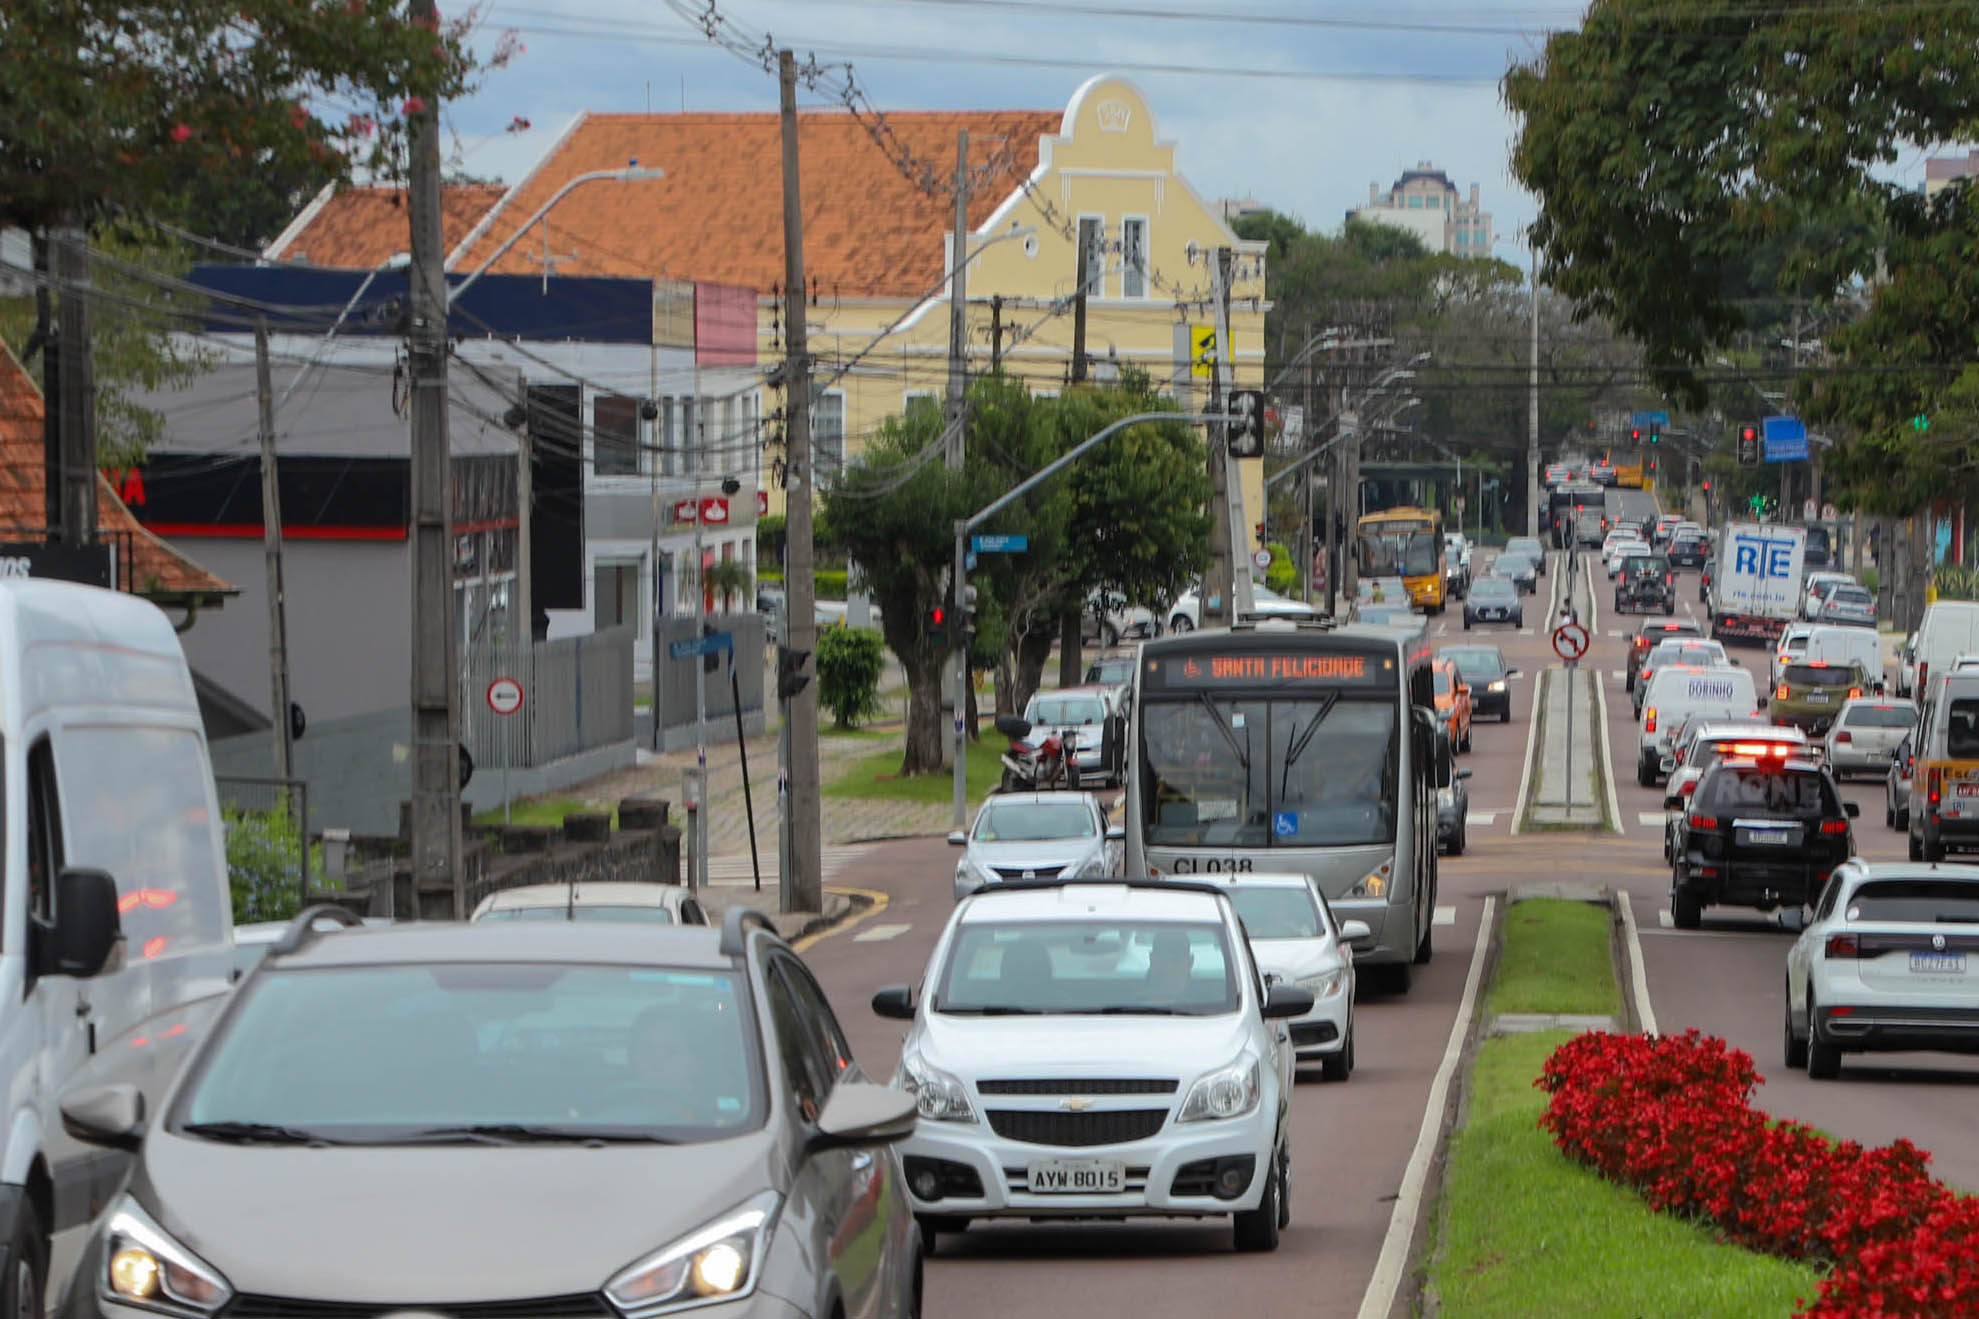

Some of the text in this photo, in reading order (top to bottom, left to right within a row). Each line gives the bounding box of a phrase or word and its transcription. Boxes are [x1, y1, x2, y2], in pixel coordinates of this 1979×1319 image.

[1735, 535, 1795, 580] RTE
[1211, 656, 1265, 679] SANTA
[1688, 680, 1734, 697] DORINHO
